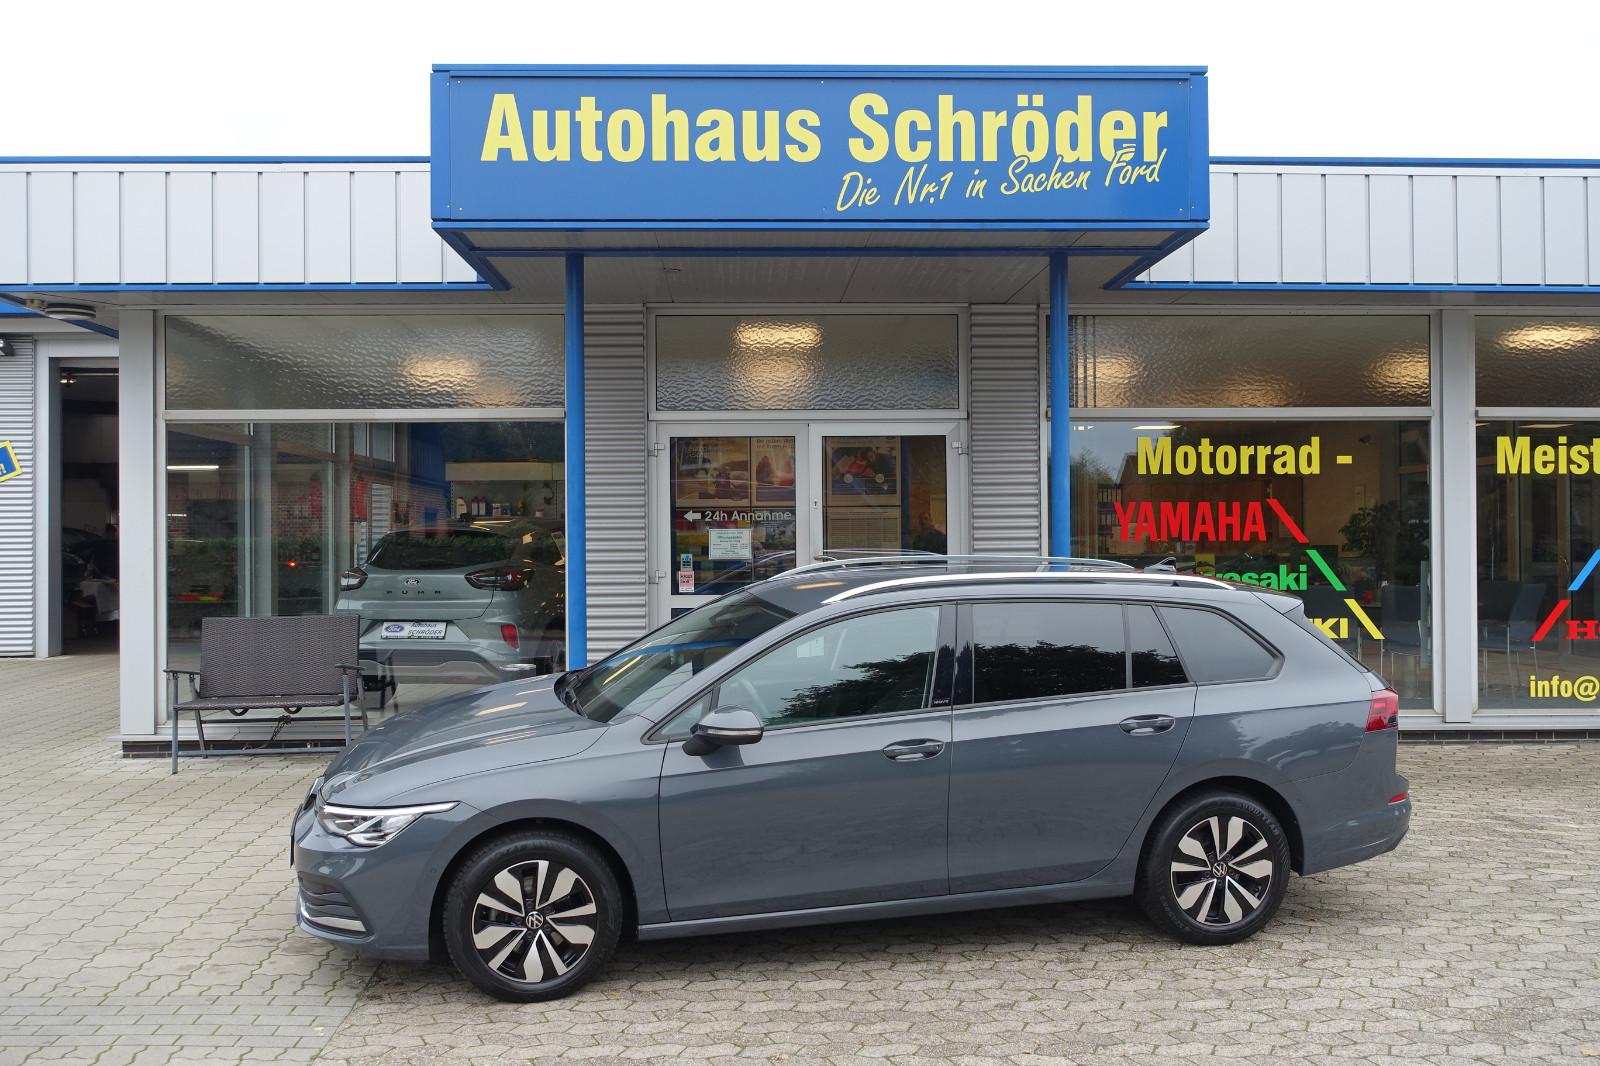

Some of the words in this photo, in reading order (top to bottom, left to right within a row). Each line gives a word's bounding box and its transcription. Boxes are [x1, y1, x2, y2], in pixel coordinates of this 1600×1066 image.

[480, 94, 821, 162] Autohaus
[848, 93, 1168, 163] Schröder
[836, 171, 881, 212] Die
[893, 163, 954, 206] Nr.1
[965, 169, 988, 199] in
[1000, 153, 1091, 196] Sachen
[1104, 148, 1167, 188] Ford
[1137, 436, 1321, 476] Motorrad
[1496, 436, 1600, 475] Meist
[704, 510, 728, 521] 24h
[731, 510, 792, 522] Annahme
[1114, 501, 1268, 542] YAMAHA
[1529, 674, 1600, 702] info@
